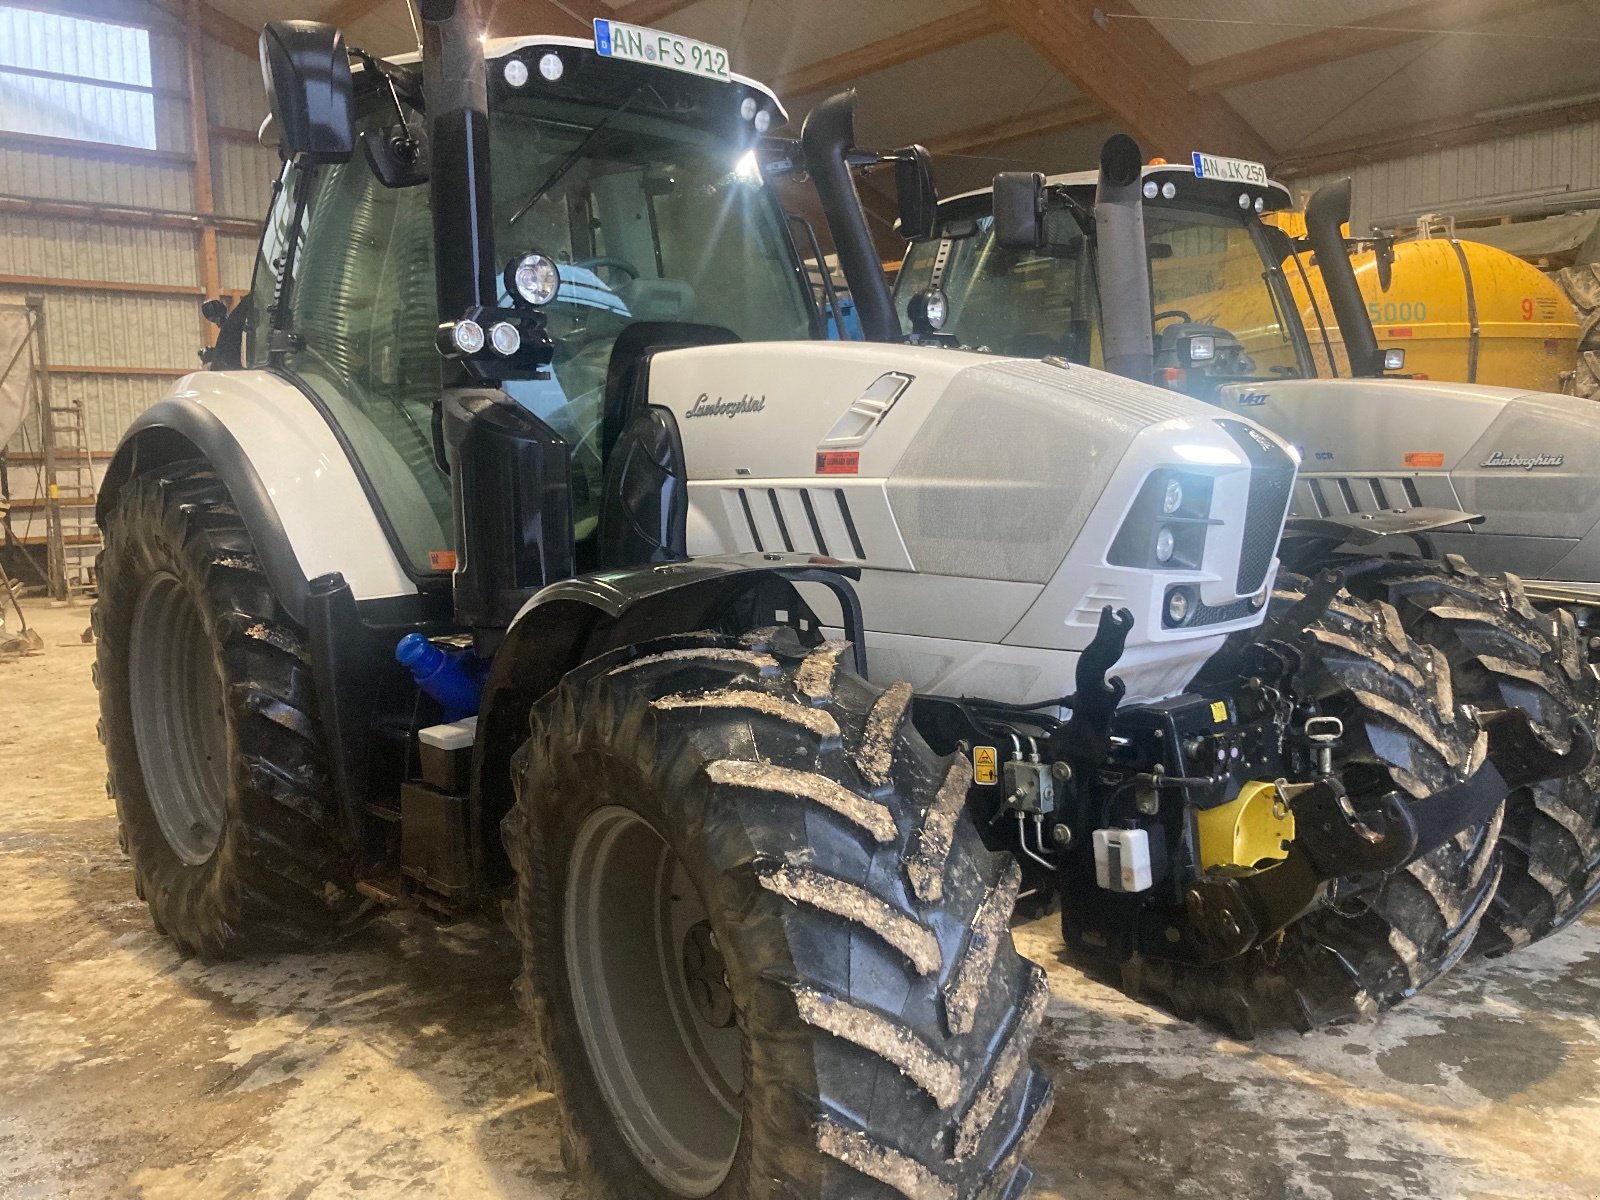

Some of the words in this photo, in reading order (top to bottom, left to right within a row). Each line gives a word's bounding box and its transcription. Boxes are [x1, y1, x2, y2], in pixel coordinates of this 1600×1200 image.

[601, 40, 608, 49] D
[613, 27, 643, 57] AN
[657, 36, 686, 66] FS
[691, 45, 728, 77] 912
[1203, 157, 1220, 177] AN
[1227, 161, 1244, 179] IK
[1244, 164, 1265, 183] 259
[1521, 298, 1534, 321] 9
[685, 392, 766, 419] Lamborghini
[1480, 451, 1564, 471] Lamborghini
